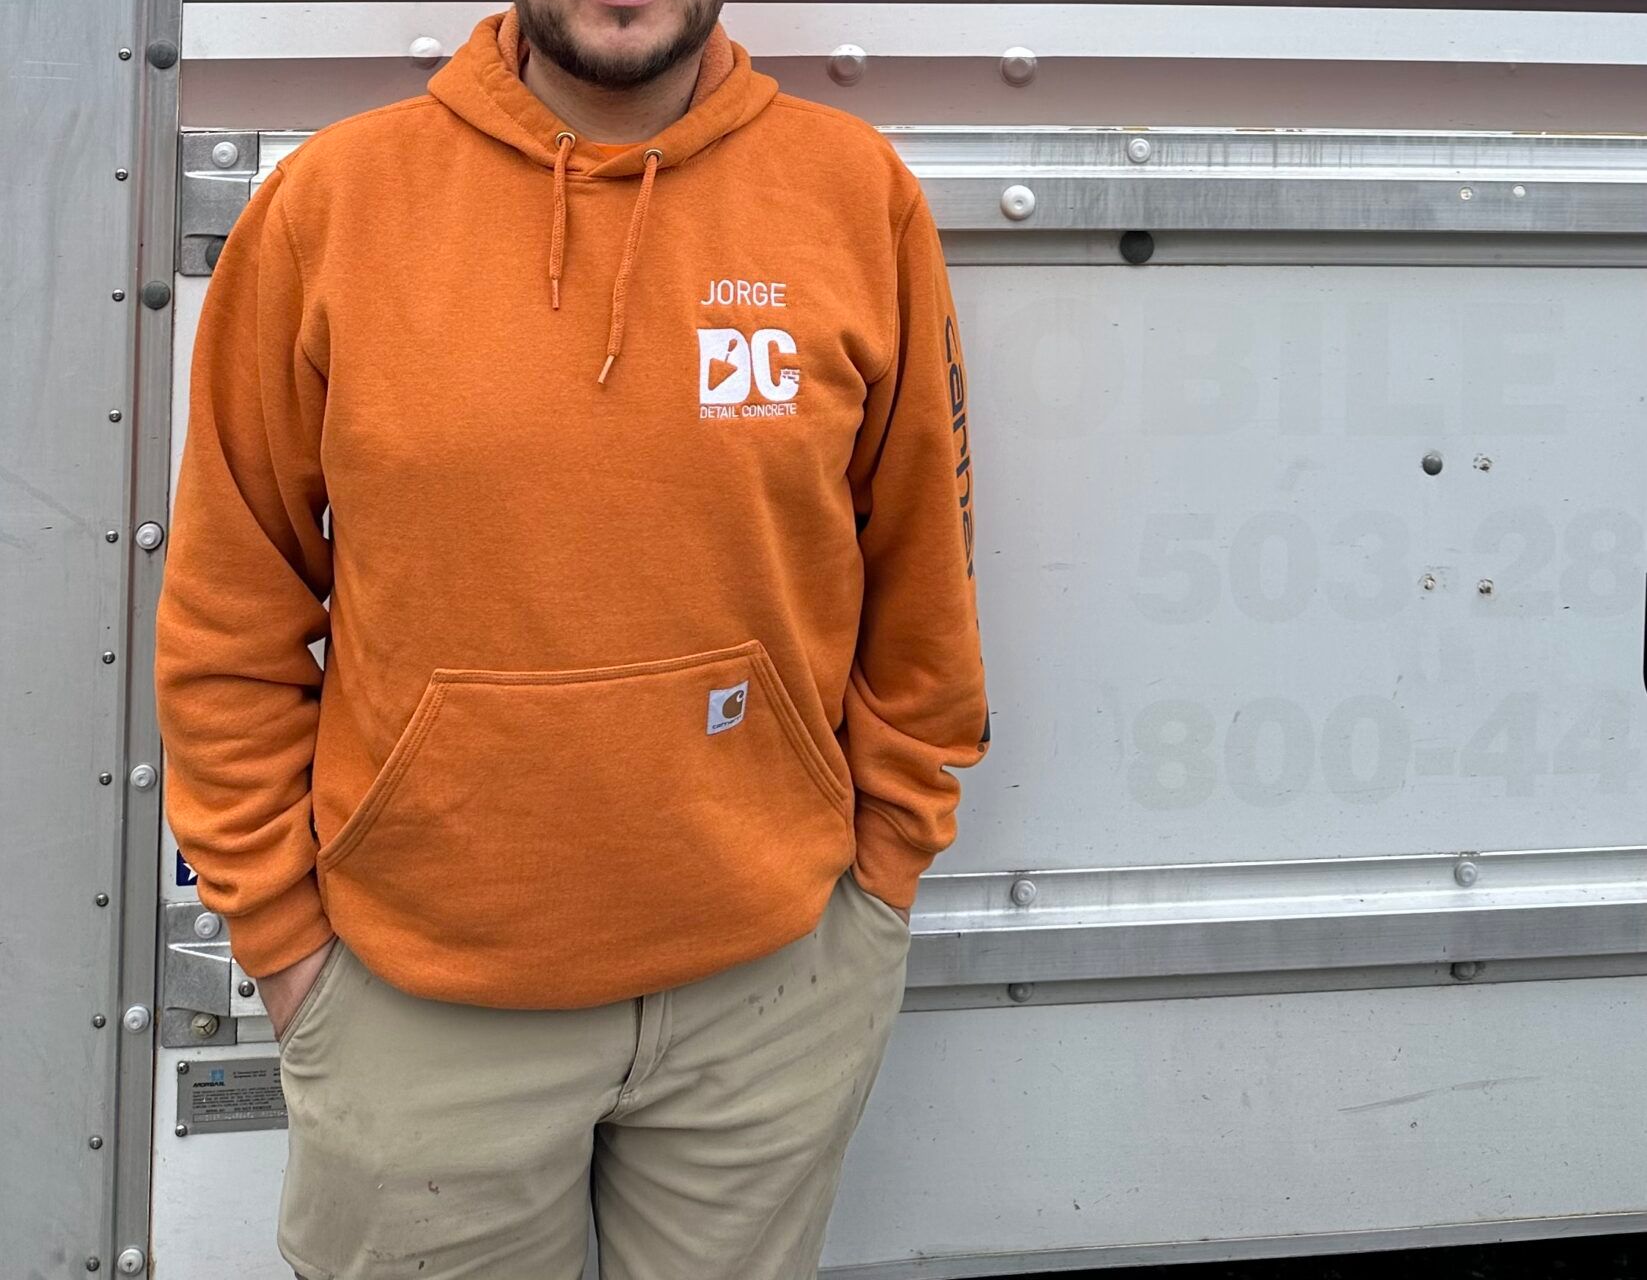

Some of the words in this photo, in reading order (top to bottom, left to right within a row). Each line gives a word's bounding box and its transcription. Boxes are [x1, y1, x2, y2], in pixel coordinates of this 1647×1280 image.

[701, 280, 787, 307] JORGE
[697, 328, 800, 405] DC
[701, 405, 738, 419] DETAIL
[742, 403, 798, 418] CONCRETE
